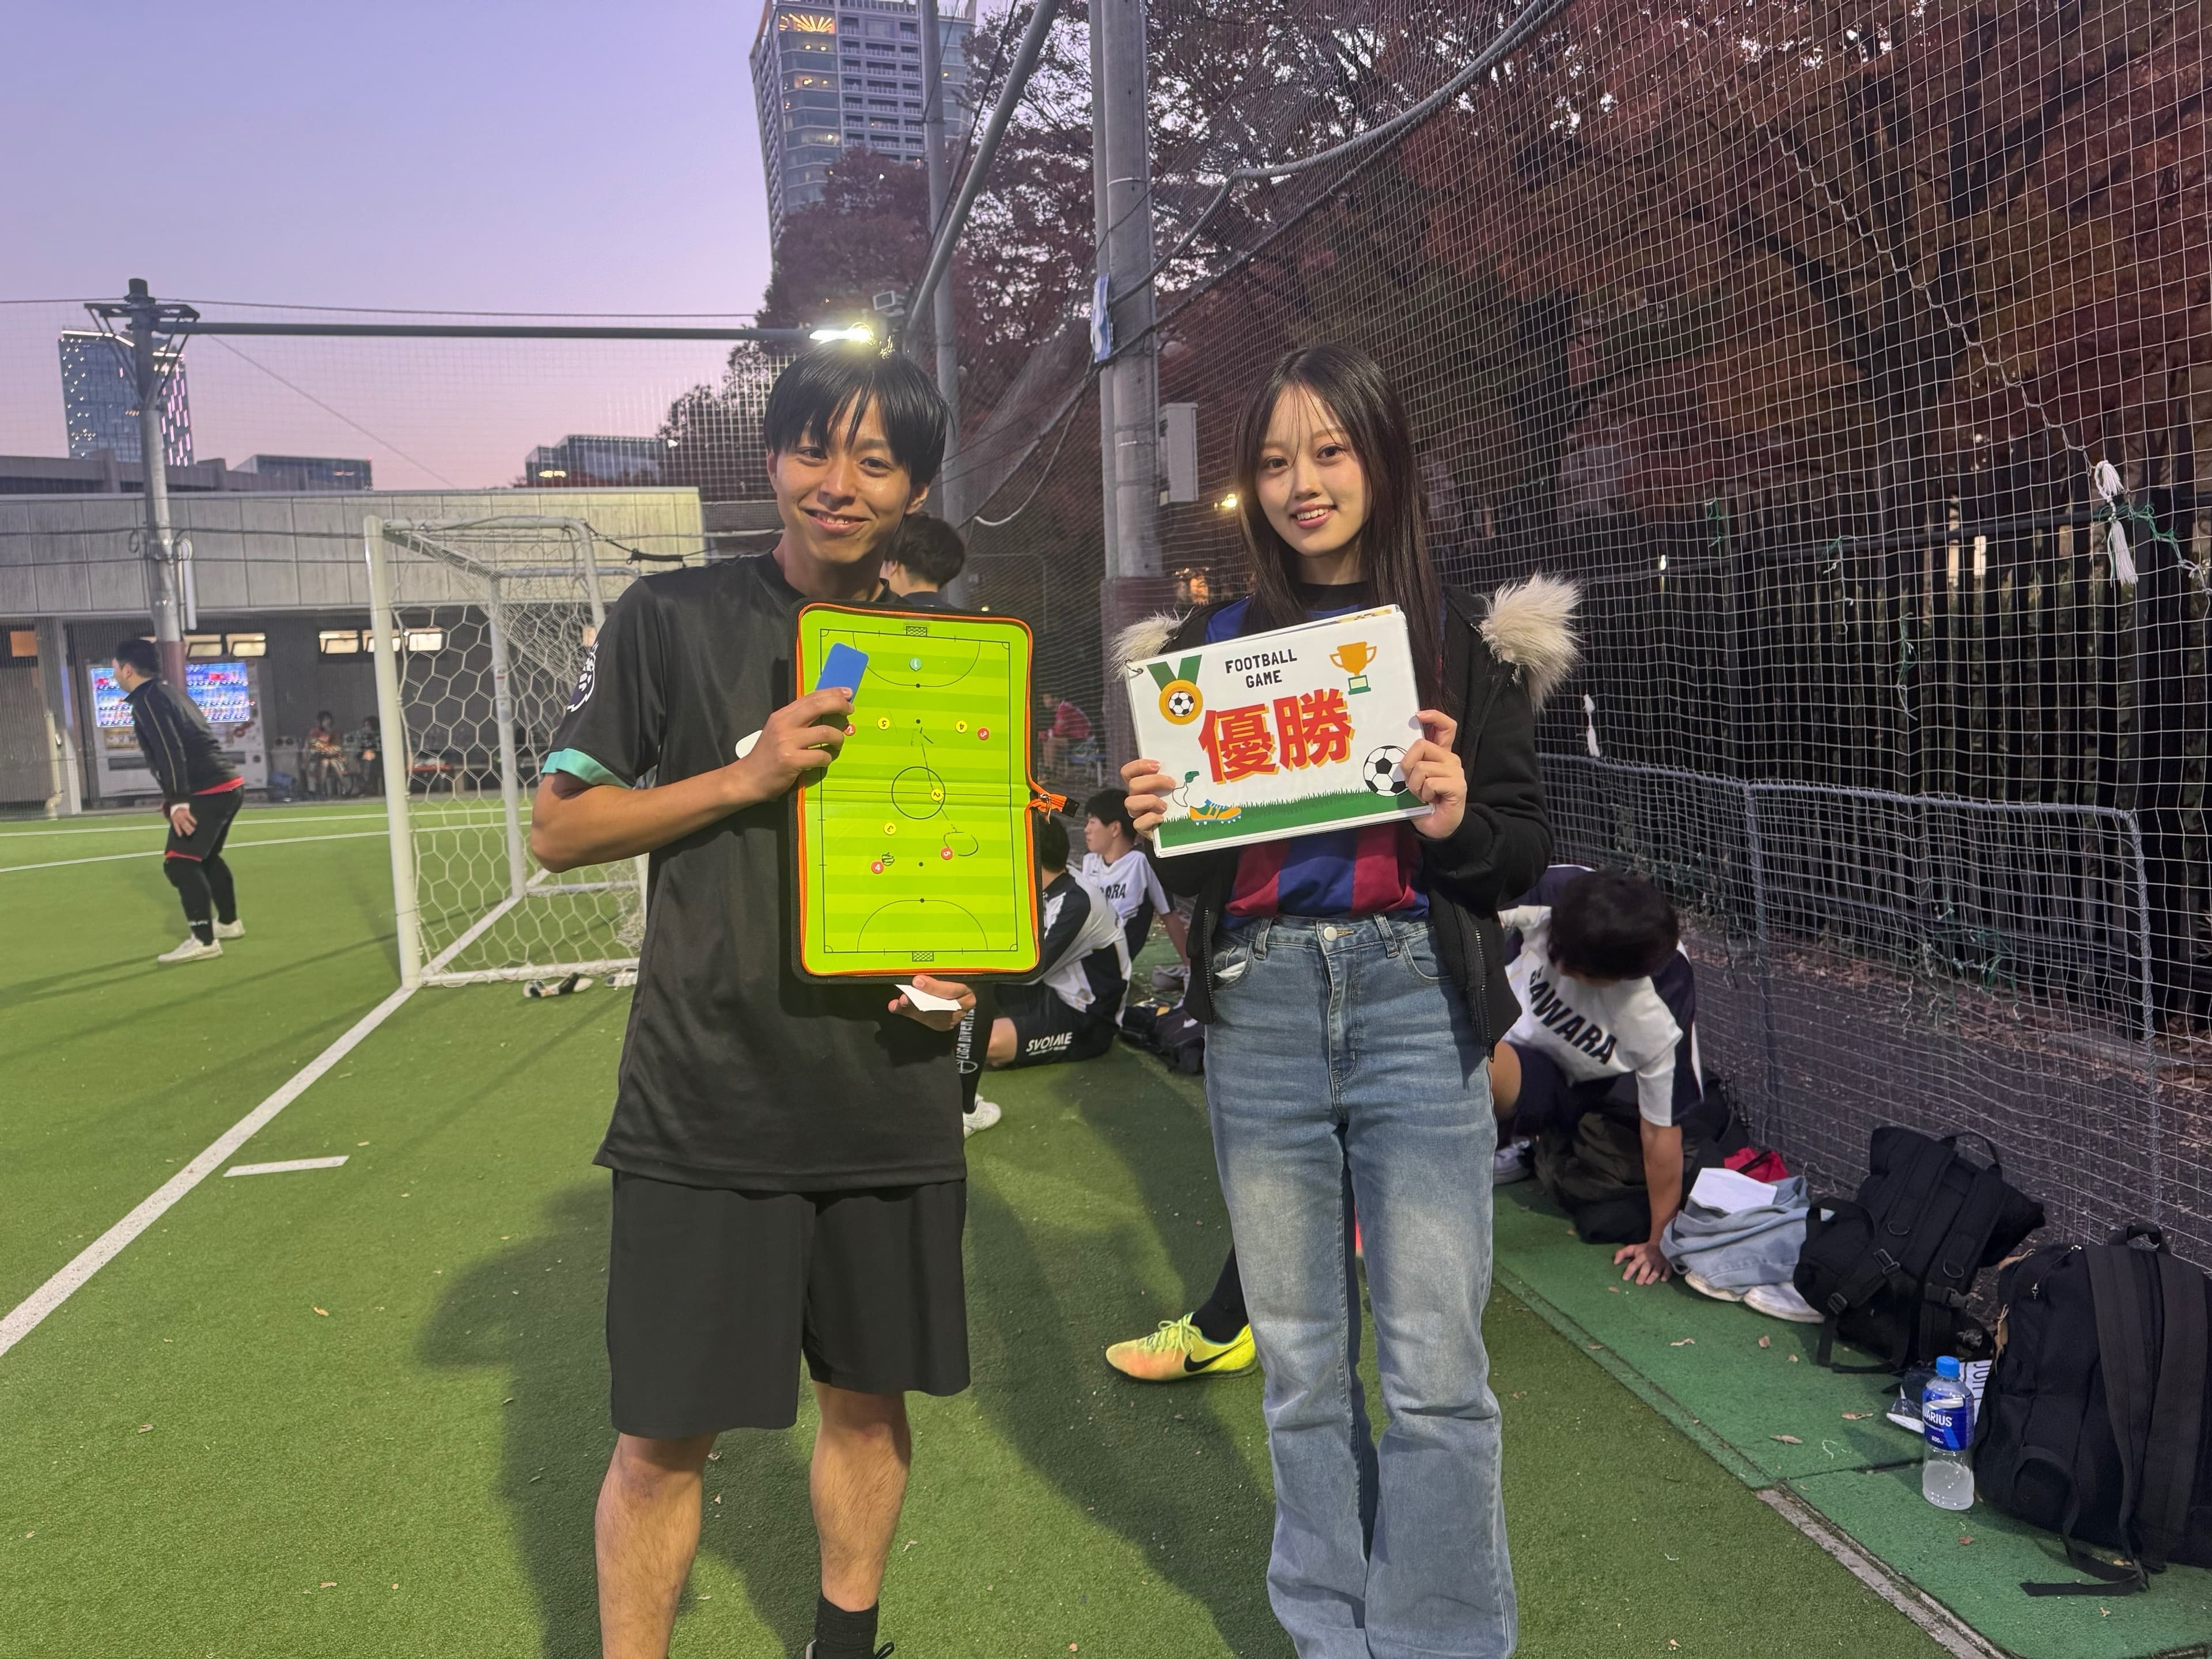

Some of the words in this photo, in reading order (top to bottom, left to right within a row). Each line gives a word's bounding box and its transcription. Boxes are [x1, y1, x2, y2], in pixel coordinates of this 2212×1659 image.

[1225, 649, 1297, 674] FOOTBALL
[1245, 669, 1283, 688] GAME
[1198, 688, 1355, 785] 優勝
